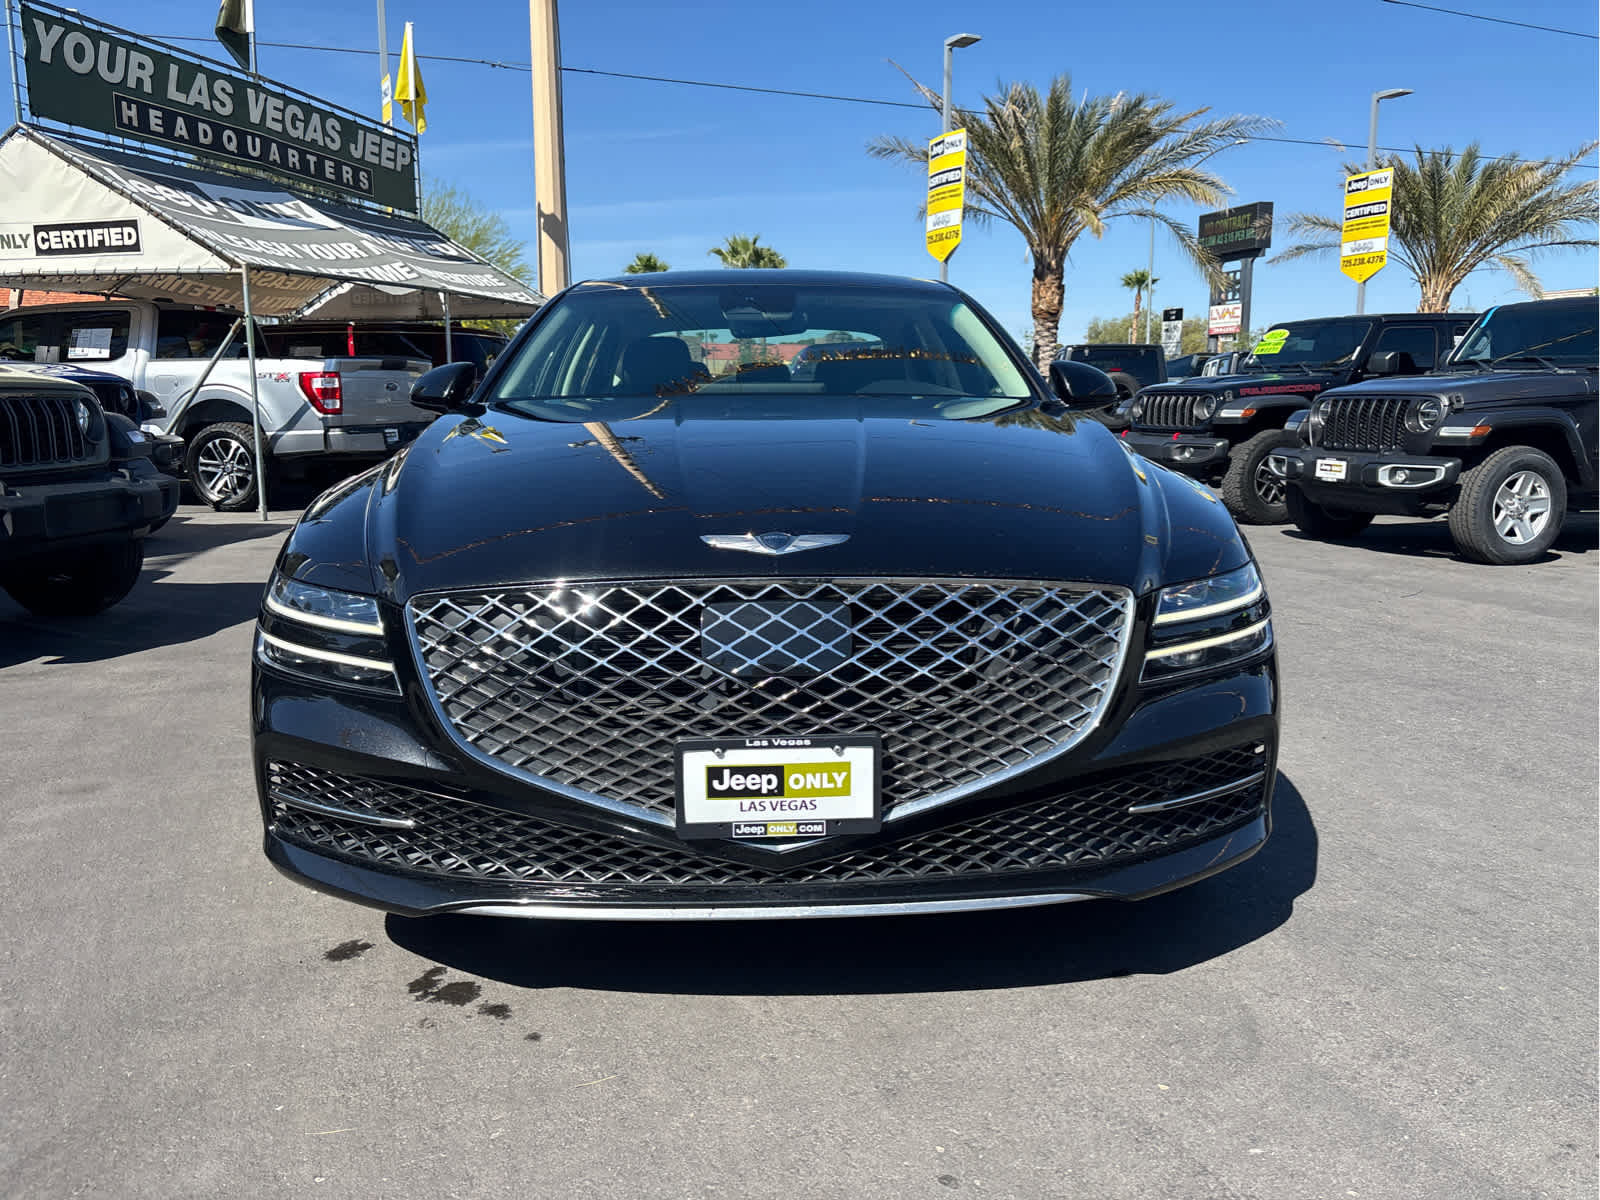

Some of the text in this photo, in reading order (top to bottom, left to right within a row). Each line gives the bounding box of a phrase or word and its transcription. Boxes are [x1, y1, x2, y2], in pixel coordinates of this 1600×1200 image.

[33, 18, 154, 94] YOUR
[166, 63, 234, 116] LAS
[247, 88, 342, 151] VEGAS
[350, 129, 411, 172] JEEP
[120, 101, 369, 190] HEADQUARTERS
[945, 139, 962, 150] ONLY
[1348, 175, 1389, 192] Jeep ONLY
[1346, 203, 1387, 219] CERTIFIED
[0, 226, 137, 250] NLY CERTIFIED
[300, 242, 369, 261] YOUR
[1350, 241, 1374, 253] Jeep
[745, 738, 812, 747] Las Vegas
[711, 768, 848, 794] Jeep ONLY
[739, 799, 818, 812] LAS VEGAS
[735, 824, 766, 835] Jeep
